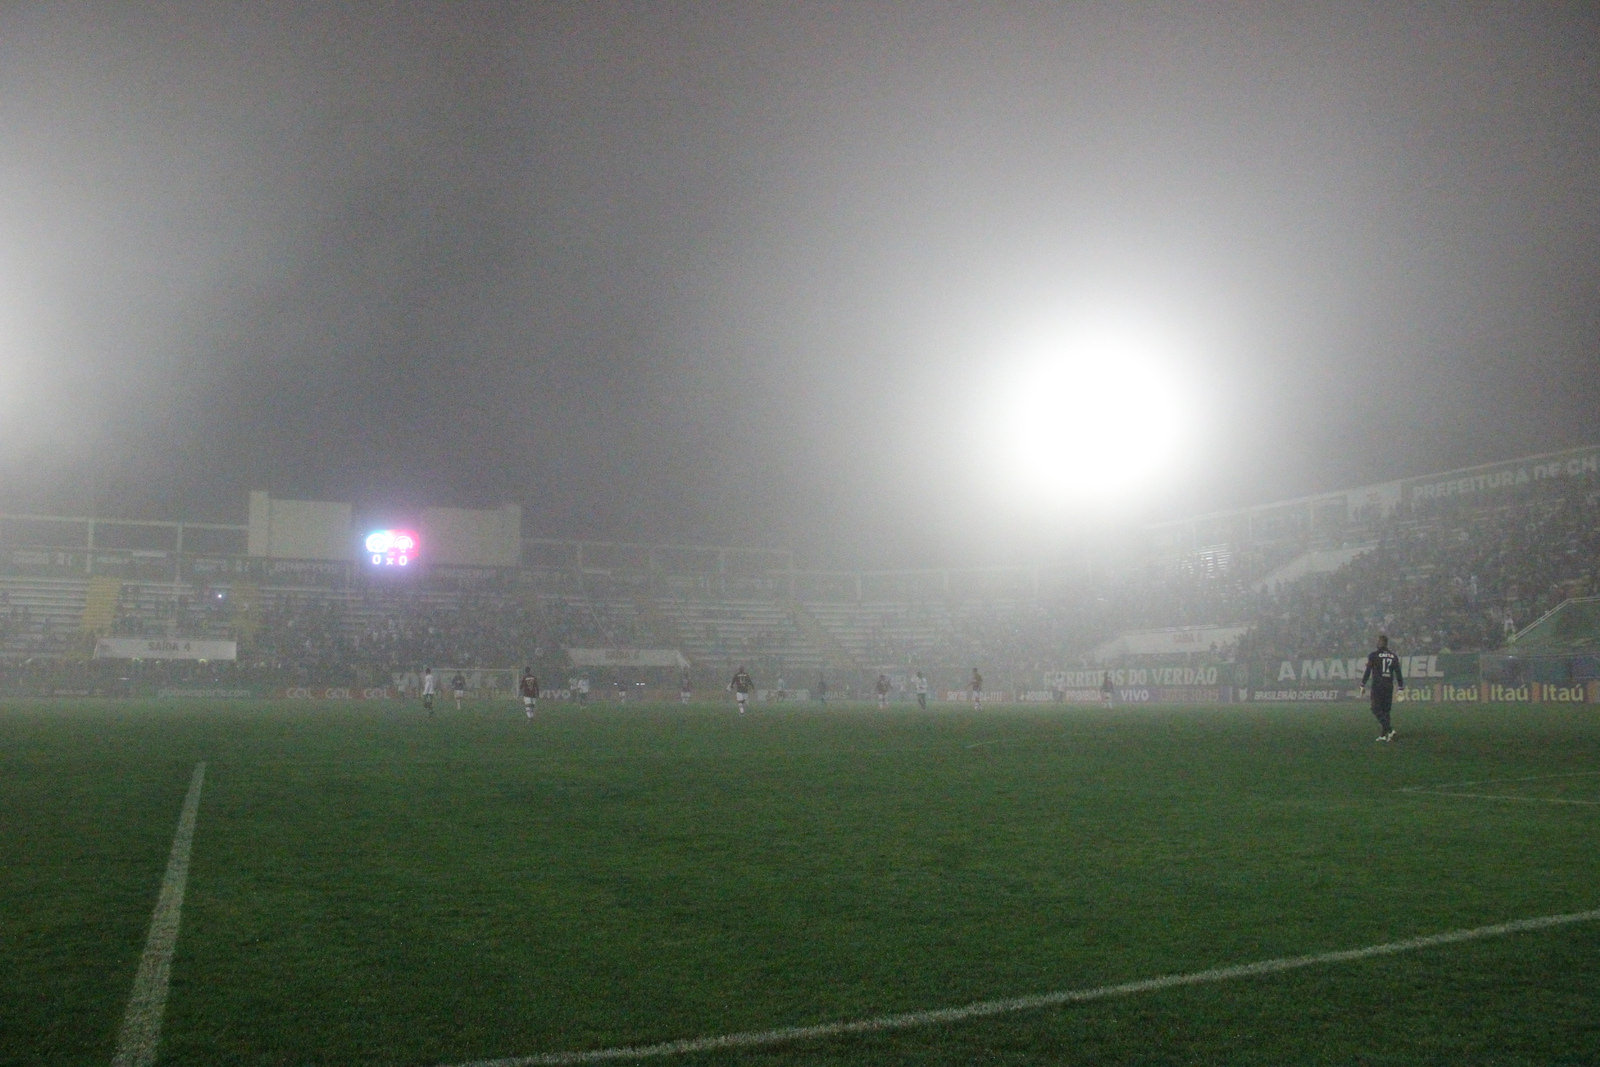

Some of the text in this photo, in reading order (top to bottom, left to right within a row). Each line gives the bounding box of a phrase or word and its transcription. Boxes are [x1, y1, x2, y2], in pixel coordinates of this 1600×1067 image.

[1412, 469, 1529, 502] PREFEITURA
[372, 554, 381, 565] 0
[399, 555, 408, 567] 0
[1128, 668, 1147, 686] DO
[1277, 660, 1296, 682] A
[1301, 657, 1369, 681] MAIS
[1404, 685, 1431, 701] taú
[1443, 685, 1478, 701] Itaú
[1491, 684, 1528, 702] Itaú
[1543, 684, 1584, 702] Itaú
